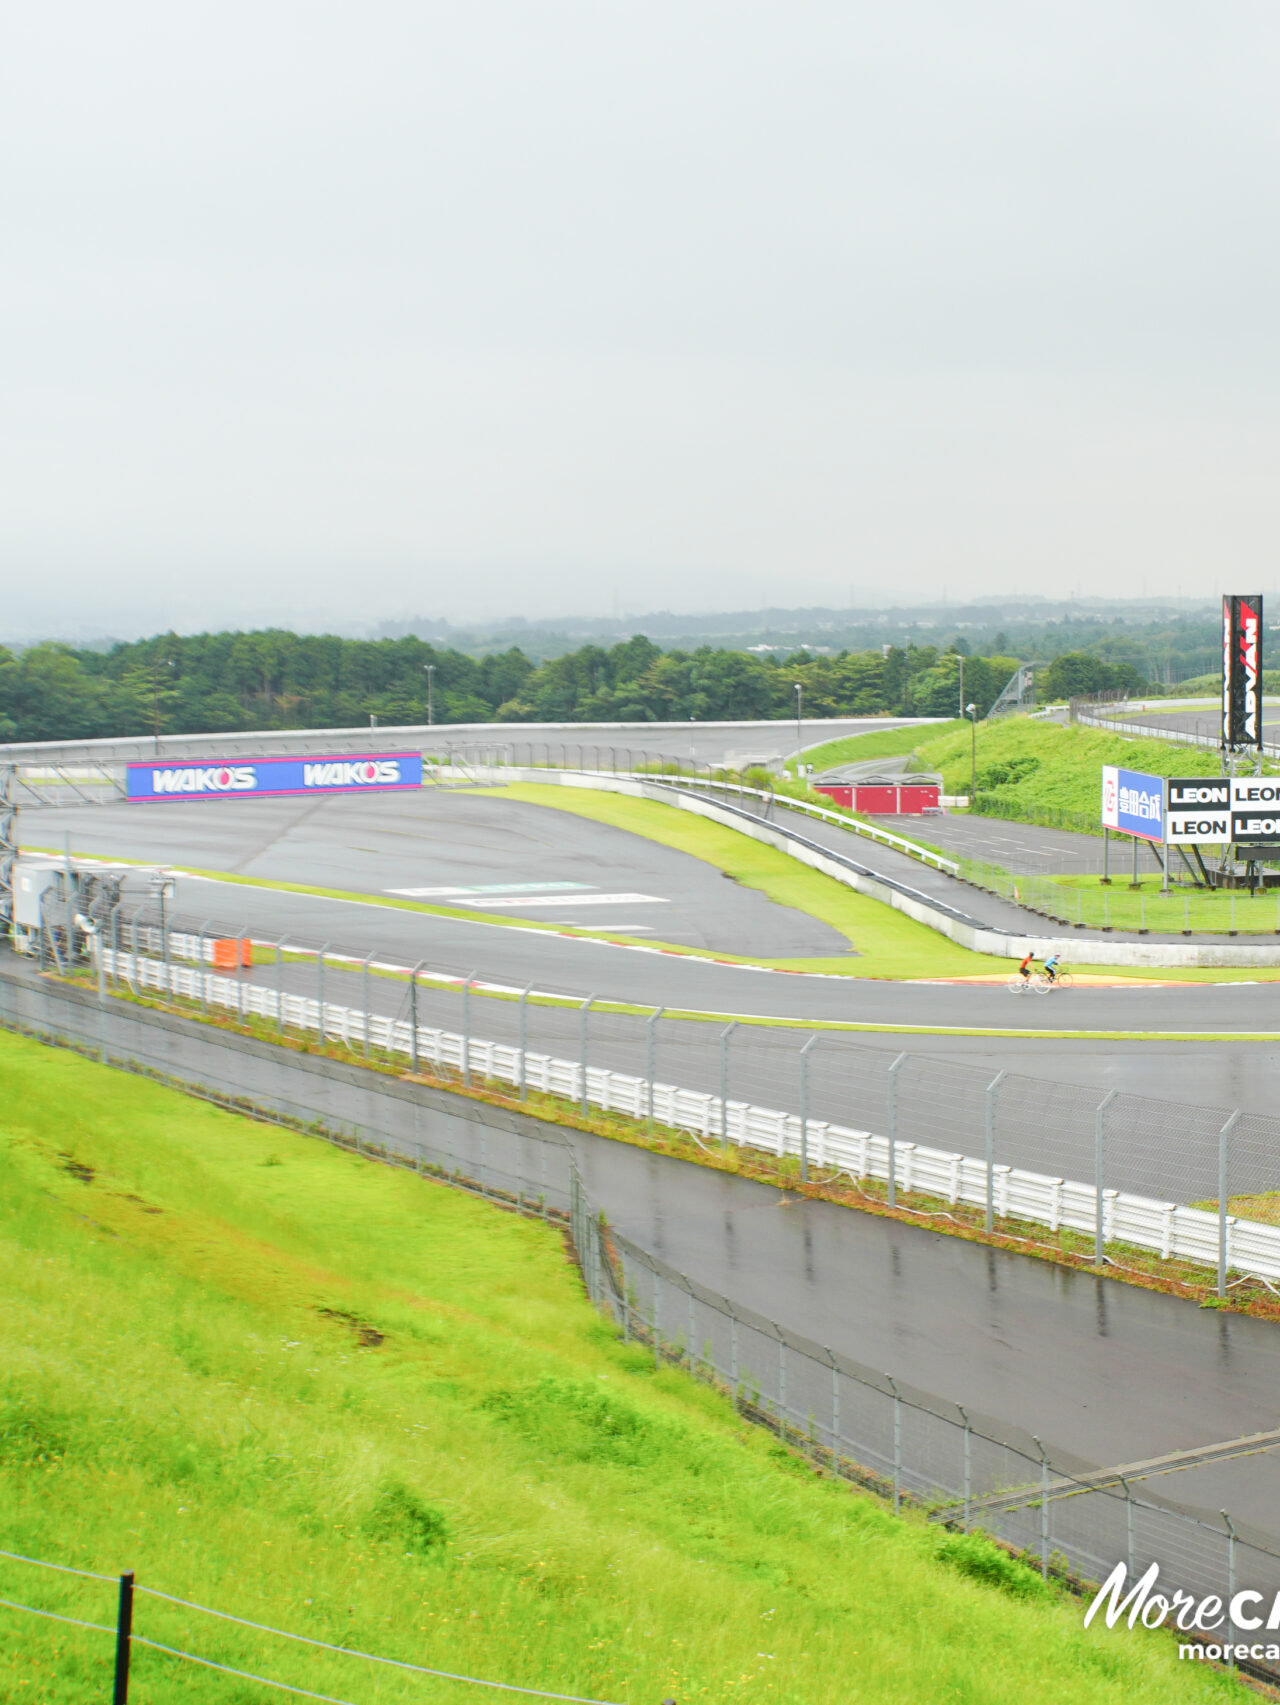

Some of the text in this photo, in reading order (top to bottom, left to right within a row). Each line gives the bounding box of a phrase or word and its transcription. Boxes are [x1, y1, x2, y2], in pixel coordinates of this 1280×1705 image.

[1245, 618, 1258, 740] ADVAN
[1119, 786, 1161, 822] 豊田合成
[1170, 787, 1228, 803] LEON
[1171, 820, 1227, 835] LEON
